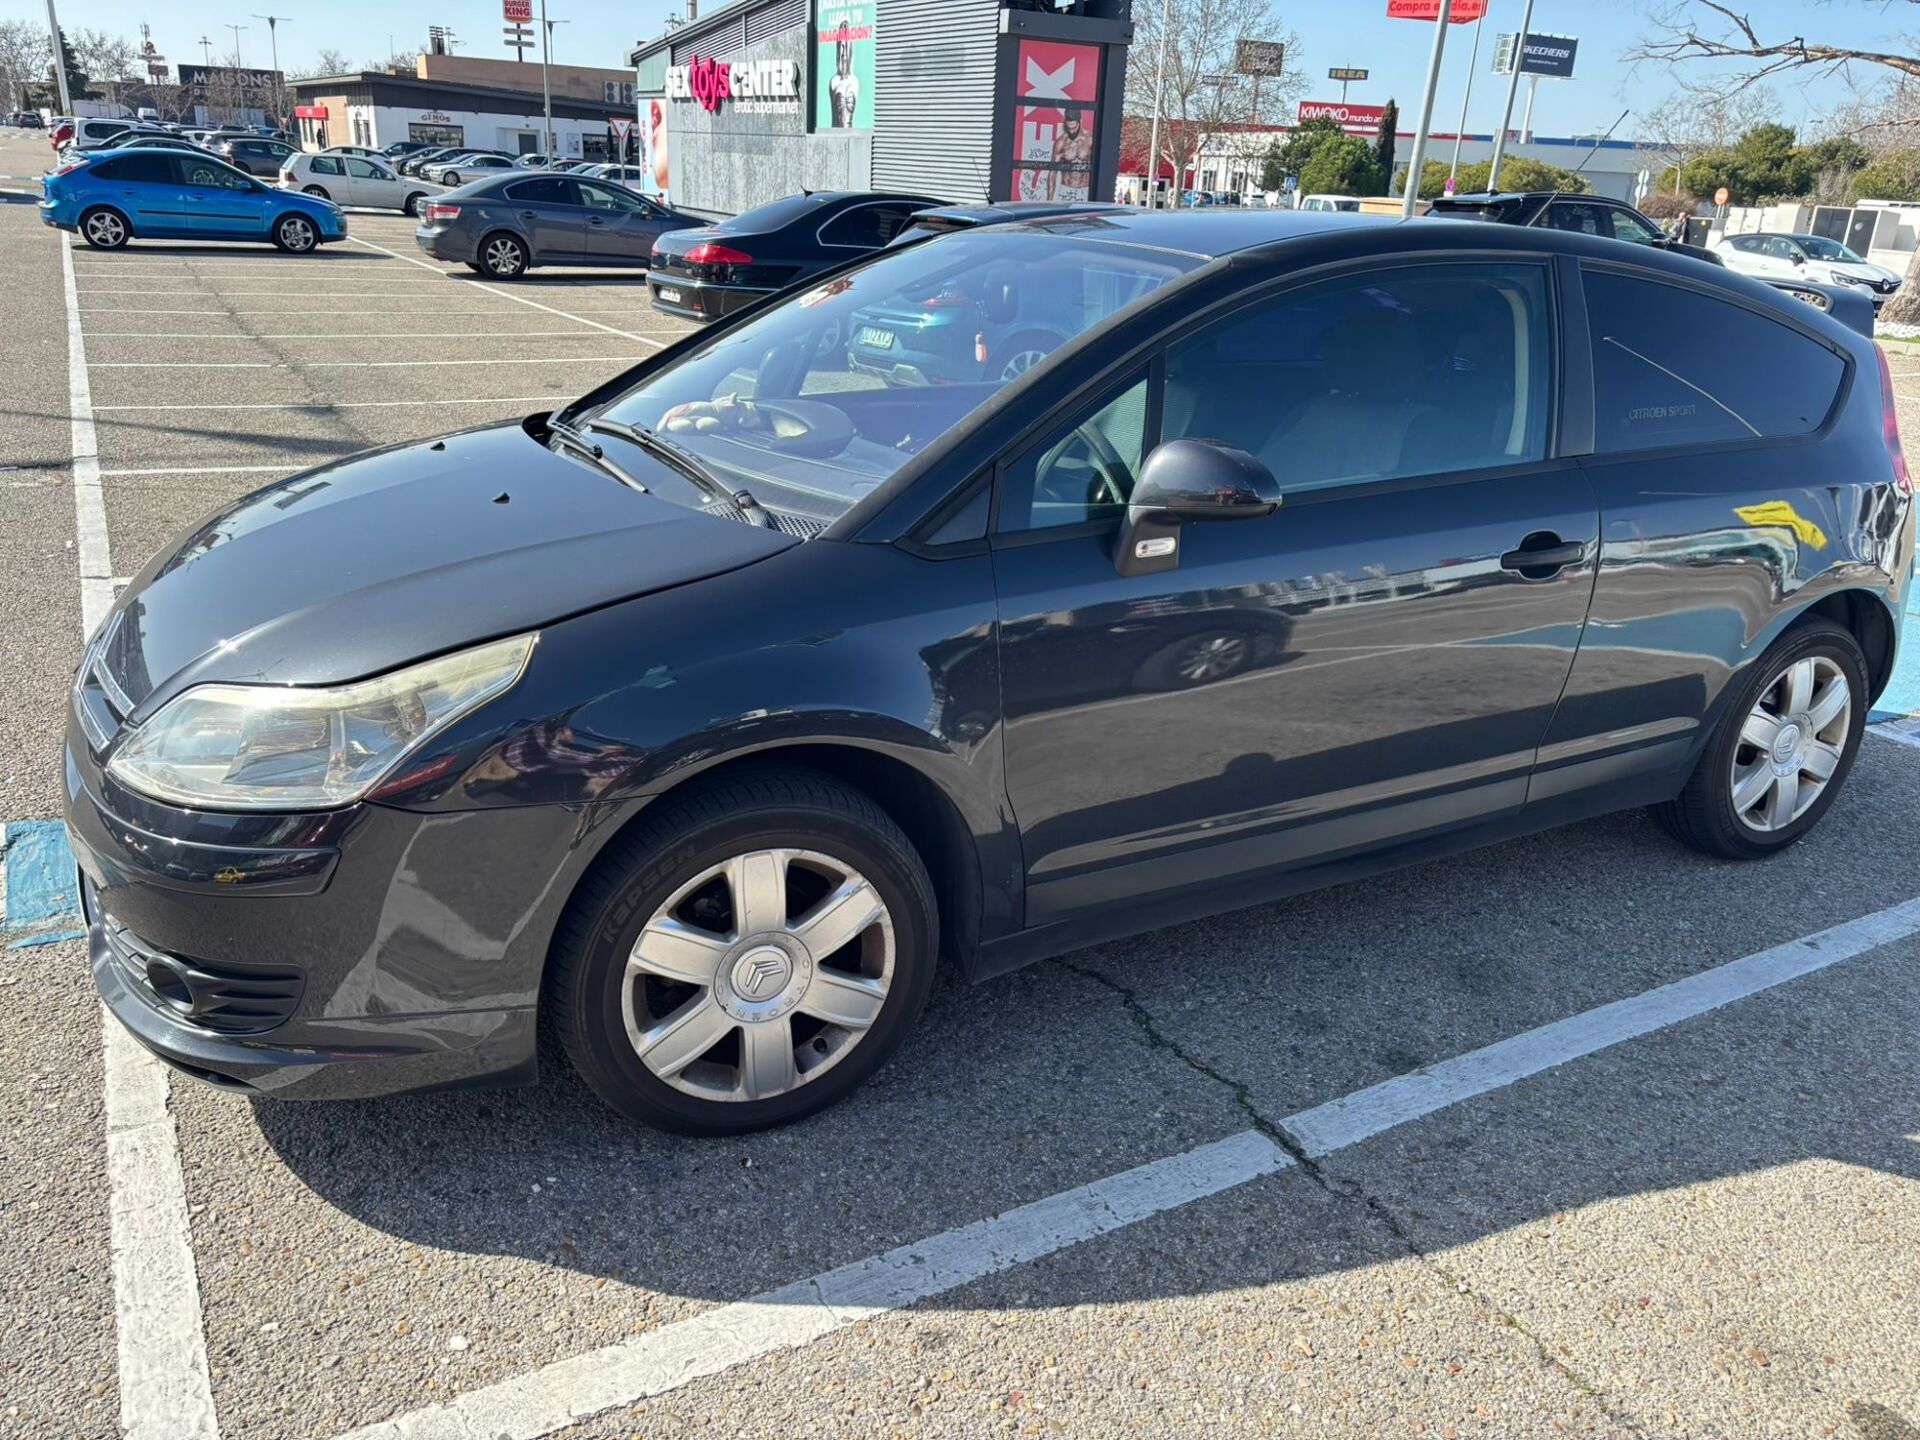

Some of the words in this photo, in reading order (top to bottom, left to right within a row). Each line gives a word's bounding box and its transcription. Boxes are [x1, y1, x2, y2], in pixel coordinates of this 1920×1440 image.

[505, 7, 531, 16] KING
[1390, 0, 1431, 13] Compra
[193, 70, 272, 89] MAISONS
[729, 60, 797, 98] CENTER
[1330, 70, 1366, 80] IKEA
[1300, 106, 1349, 121] KIWOKO
[1348, 114, 1373, 122] mundo
[1667, 404, 1696, 417] SPORT
